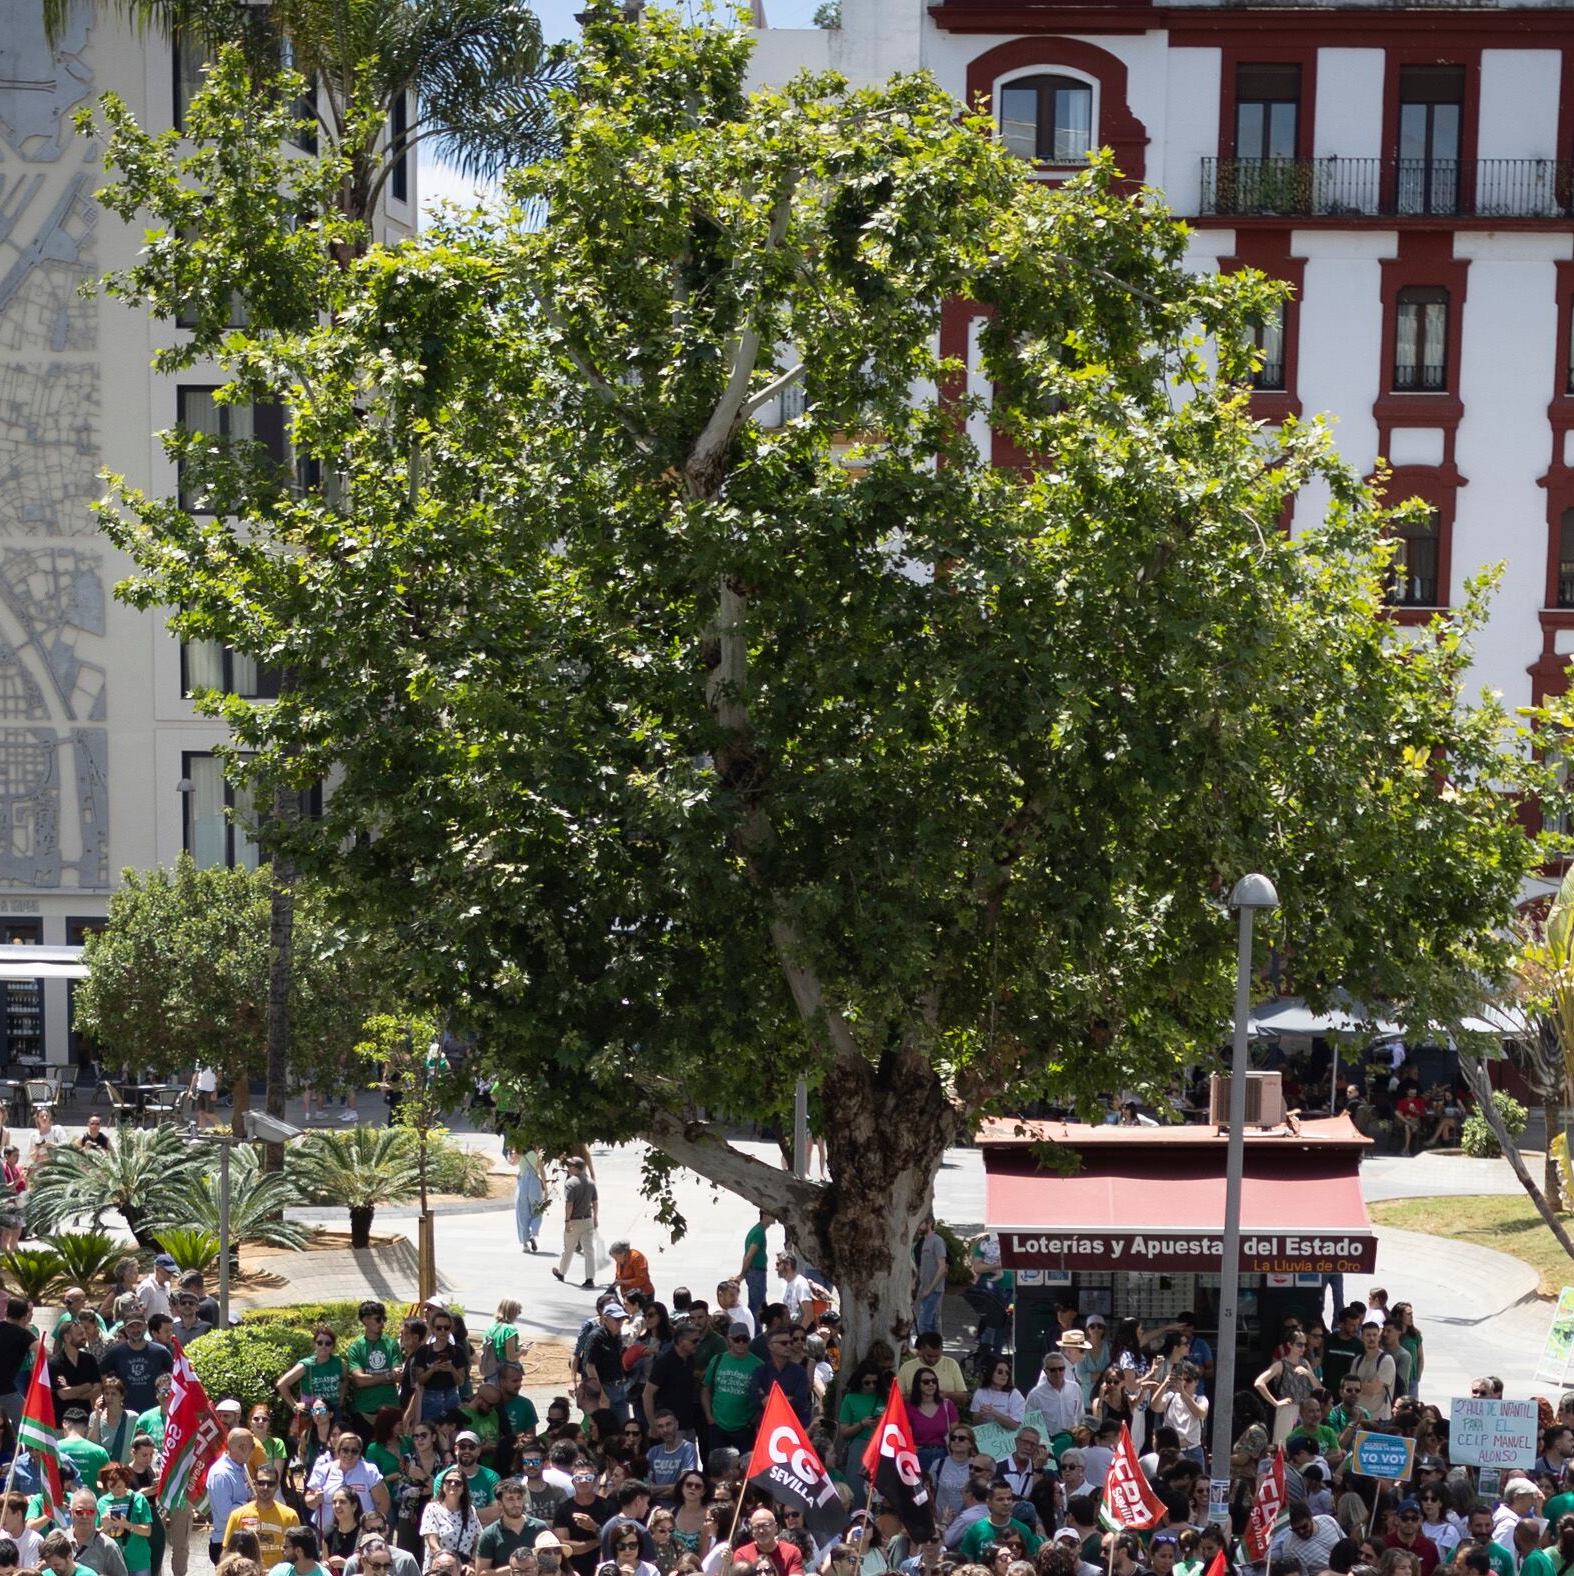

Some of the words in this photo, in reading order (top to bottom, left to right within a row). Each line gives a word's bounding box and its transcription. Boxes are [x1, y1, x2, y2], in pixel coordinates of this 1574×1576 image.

[1013, 1234, 1104, 1254] Loterías
[1111, 1240, 1125, 1258] y
[1130, 1236, 1224, 1257] Apuesta
[1244, 1237, 1277, 1255] del
[1285, 1237, 1363, 1256] Estado
[1254, 1259, 1270, 1271] La
[1273, 1259, 1313, 1272] Lluvia
[1316, 1259, 1333, 1272] de
[1337, 1259, 1361, 1272] Oro
[1486, 1402, 1497, 1417] DE
[1500, 1403, 1534, 1419] INFANTIL
[1462, 1418, 1483, 1432] PARA
[1496, 1419, 1514, 1433] EL
[1493, 1435, 1532, 1449] MANUEL
[1361, 1453, 1377, 1463] YO
[1381, 1454, 1407, 1464] VOY
[1478, 1449, 1517, 1462] ALONSO
[768, 1426, 840, 1509] CGT
[769, 1465, 815, 1509] SEVILLA
